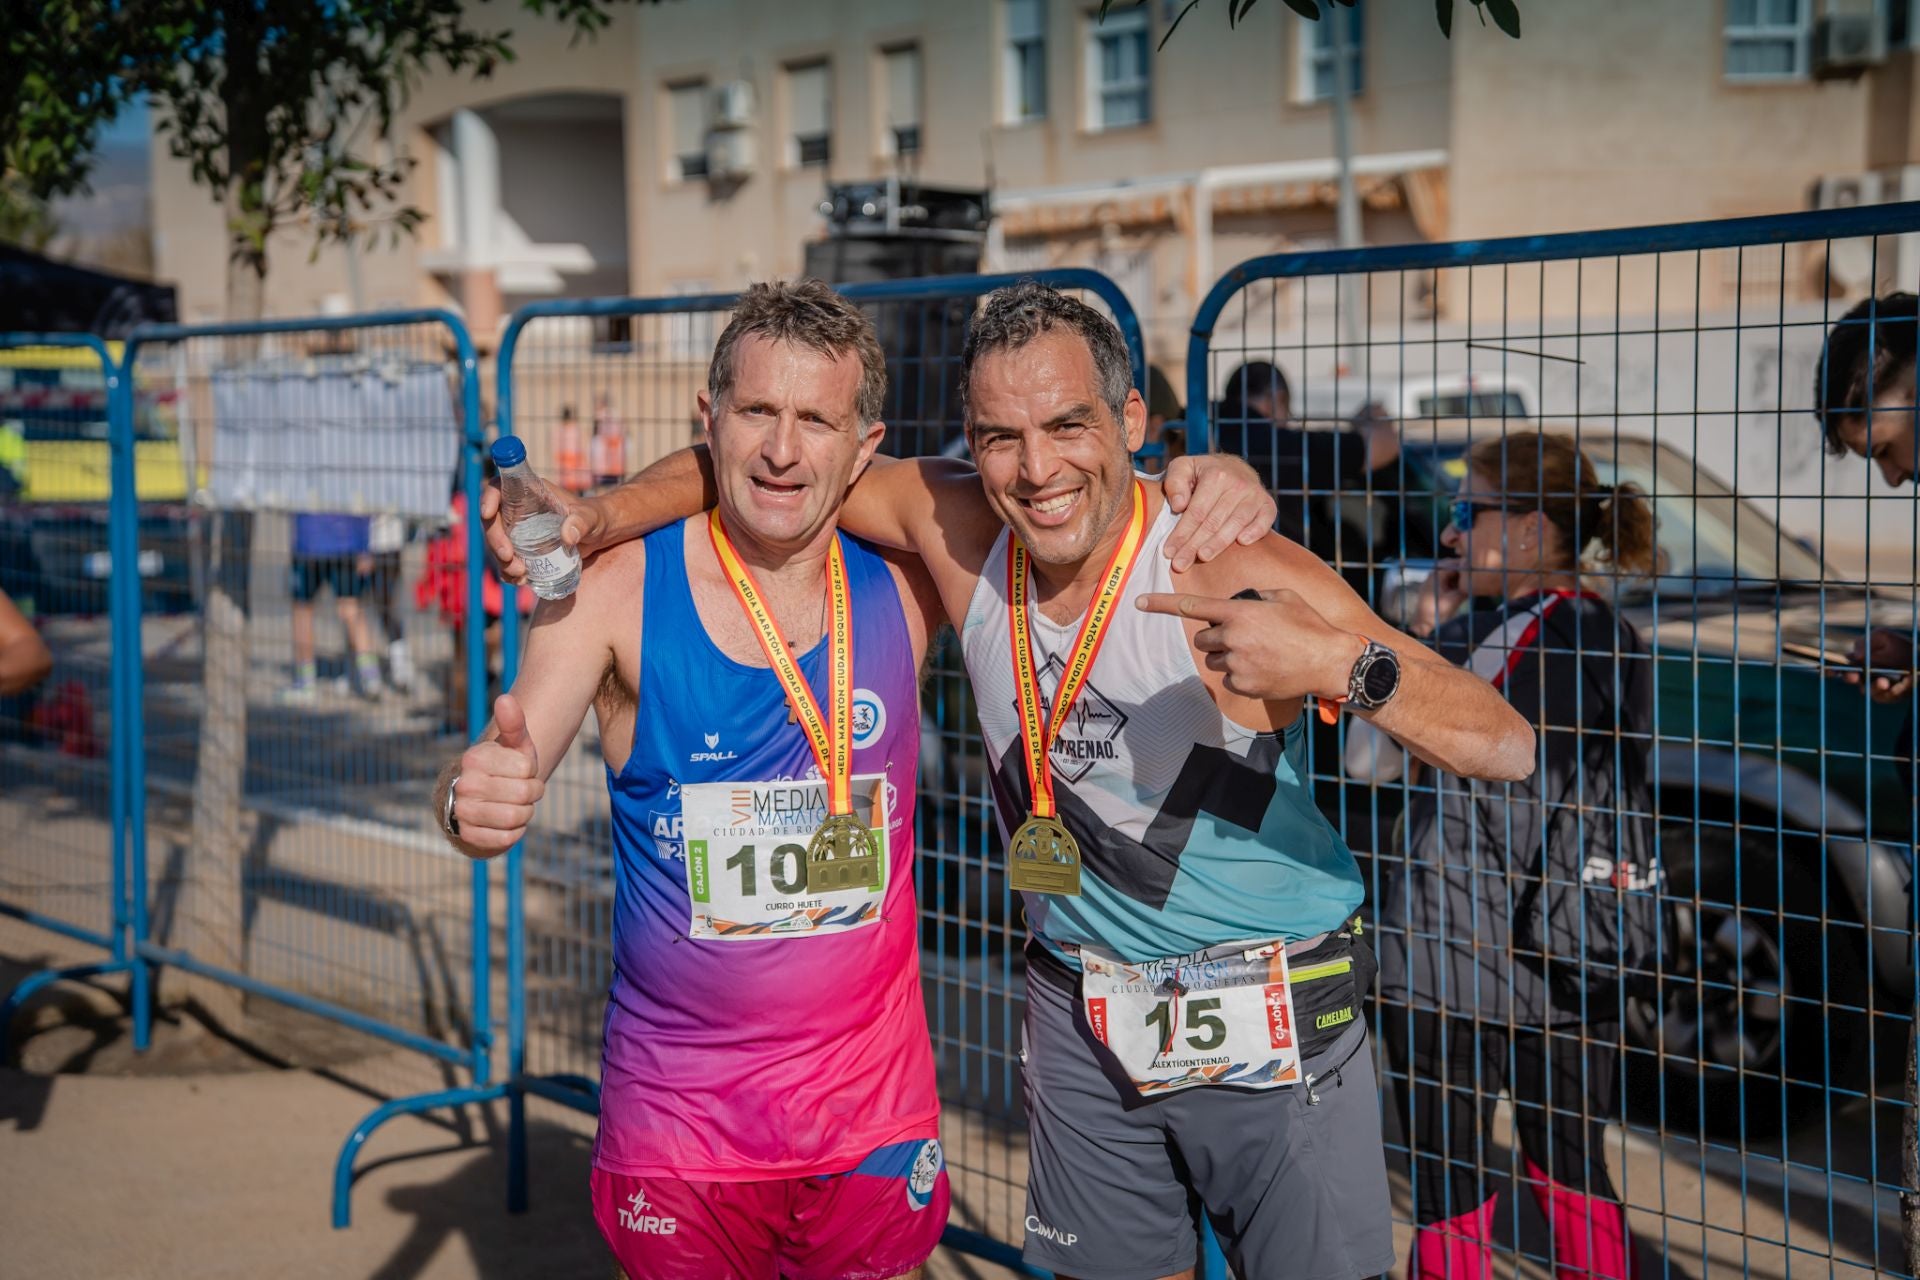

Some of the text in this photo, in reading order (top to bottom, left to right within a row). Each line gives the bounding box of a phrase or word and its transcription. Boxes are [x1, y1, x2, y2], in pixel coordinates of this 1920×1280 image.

[1015, 547, 1024, 580] MEDIA
[834, 580, 843, 590] DE
[1104, 566, 1123, 596] MEDIA
[836, 593, 845, 644] ROQUETAS
[1015, 583, 1025, 635] MARATÓN
[1082, 600, 1109, 650] MARATÓN
[738, 579, 758, 608] MEDIA
[755, 610, 783, 655] MARATÓN
[779, 657, 801, 694] CIUDAD
[797, 695, 825, 746] ROQUETAS
[837, 647, 845, 686] CIUDAD
[1018, 638, 1029, 679] CIUDAD
[1067, 652, 1087, 690] CIUDAD
[836, 689, 845, 740] MARATÓN
[1023, 682, 1038, 738] ROQUETAS
[690, 751, 738, 762] SPALL
[837, 744, 845, 776] MEDIA
[1032, 741, 1041, 755] DE
[754, 786, 825, 813] MEDIA
[713, 828, 765, 837] CIUDAD
[773, 827, 789, 835] DE
[694, 856, 706, 895] CAJÓN
[765, 899, 823, 911] CURRO HUETE
[1112, 984, 1157, 994] CIUDAD
[1187, 976, 1256, 992] ROQUETAS
[1145, 997, 1227, 1053] 15
[1272, 1003, 1285, 1040] CAJÓN
[1316, 1006, 1354, 1030] CAMELBAK
[617, 1207, 677, 1235] TMRG
[1025, 1215, 1078, 1246] CIMALP
